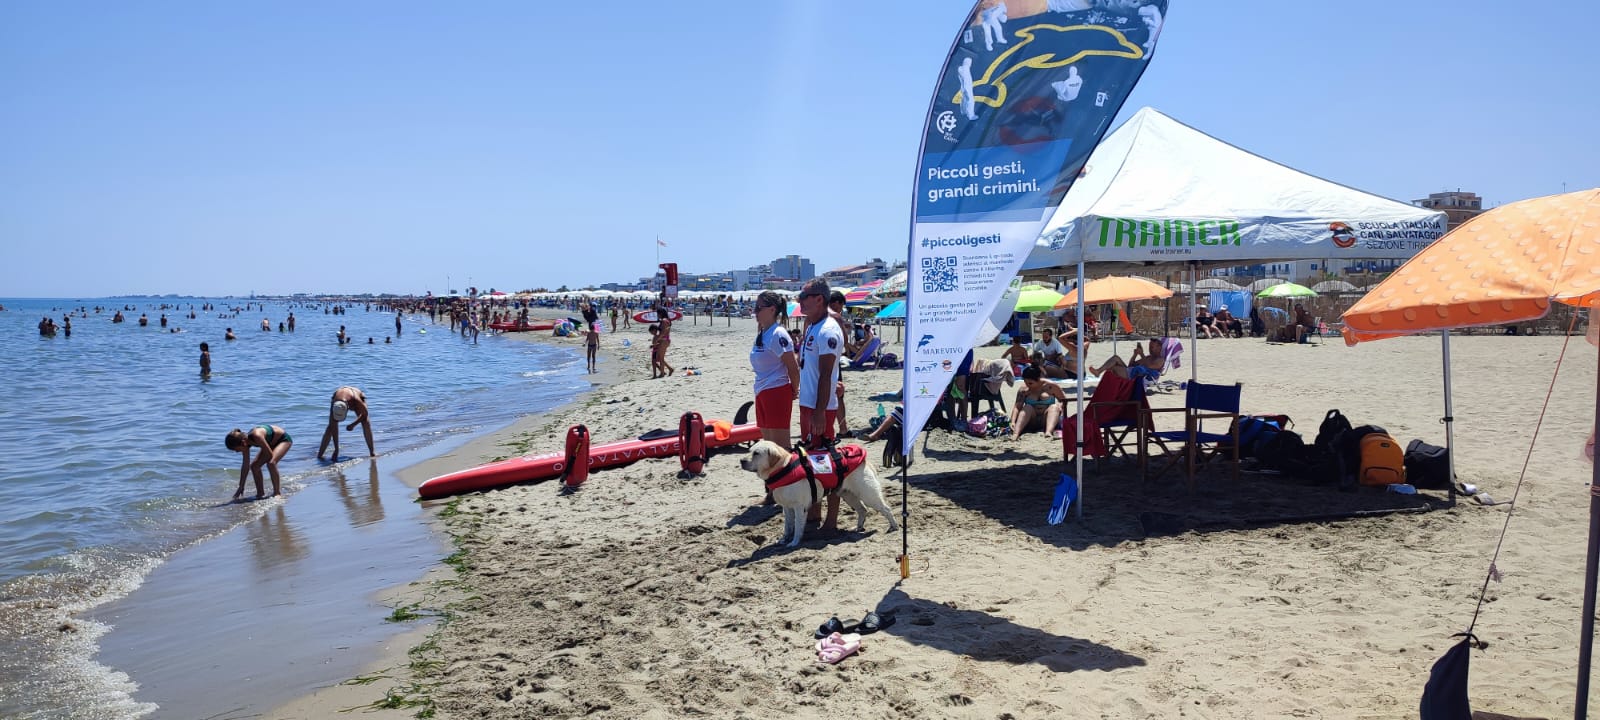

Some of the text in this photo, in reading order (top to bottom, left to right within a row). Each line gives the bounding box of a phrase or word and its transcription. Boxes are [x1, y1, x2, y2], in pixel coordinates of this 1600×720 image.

[928, 160, 1025, 181] Piccoli gesti,
[928, 178, 1041, 202] grandi crimini.
[1097, 216, 1241, 248] TRAINER
[1358, 221, 1441, 230] SCUOLA ITALIANA
[921, 233, 1001, 249] #piccoligesti
[1360, 231, 1384, 239] CANI
[1366, 240, 1405, 250] SEZIONE
[923, 347, 963, 355] MAREVIVO
